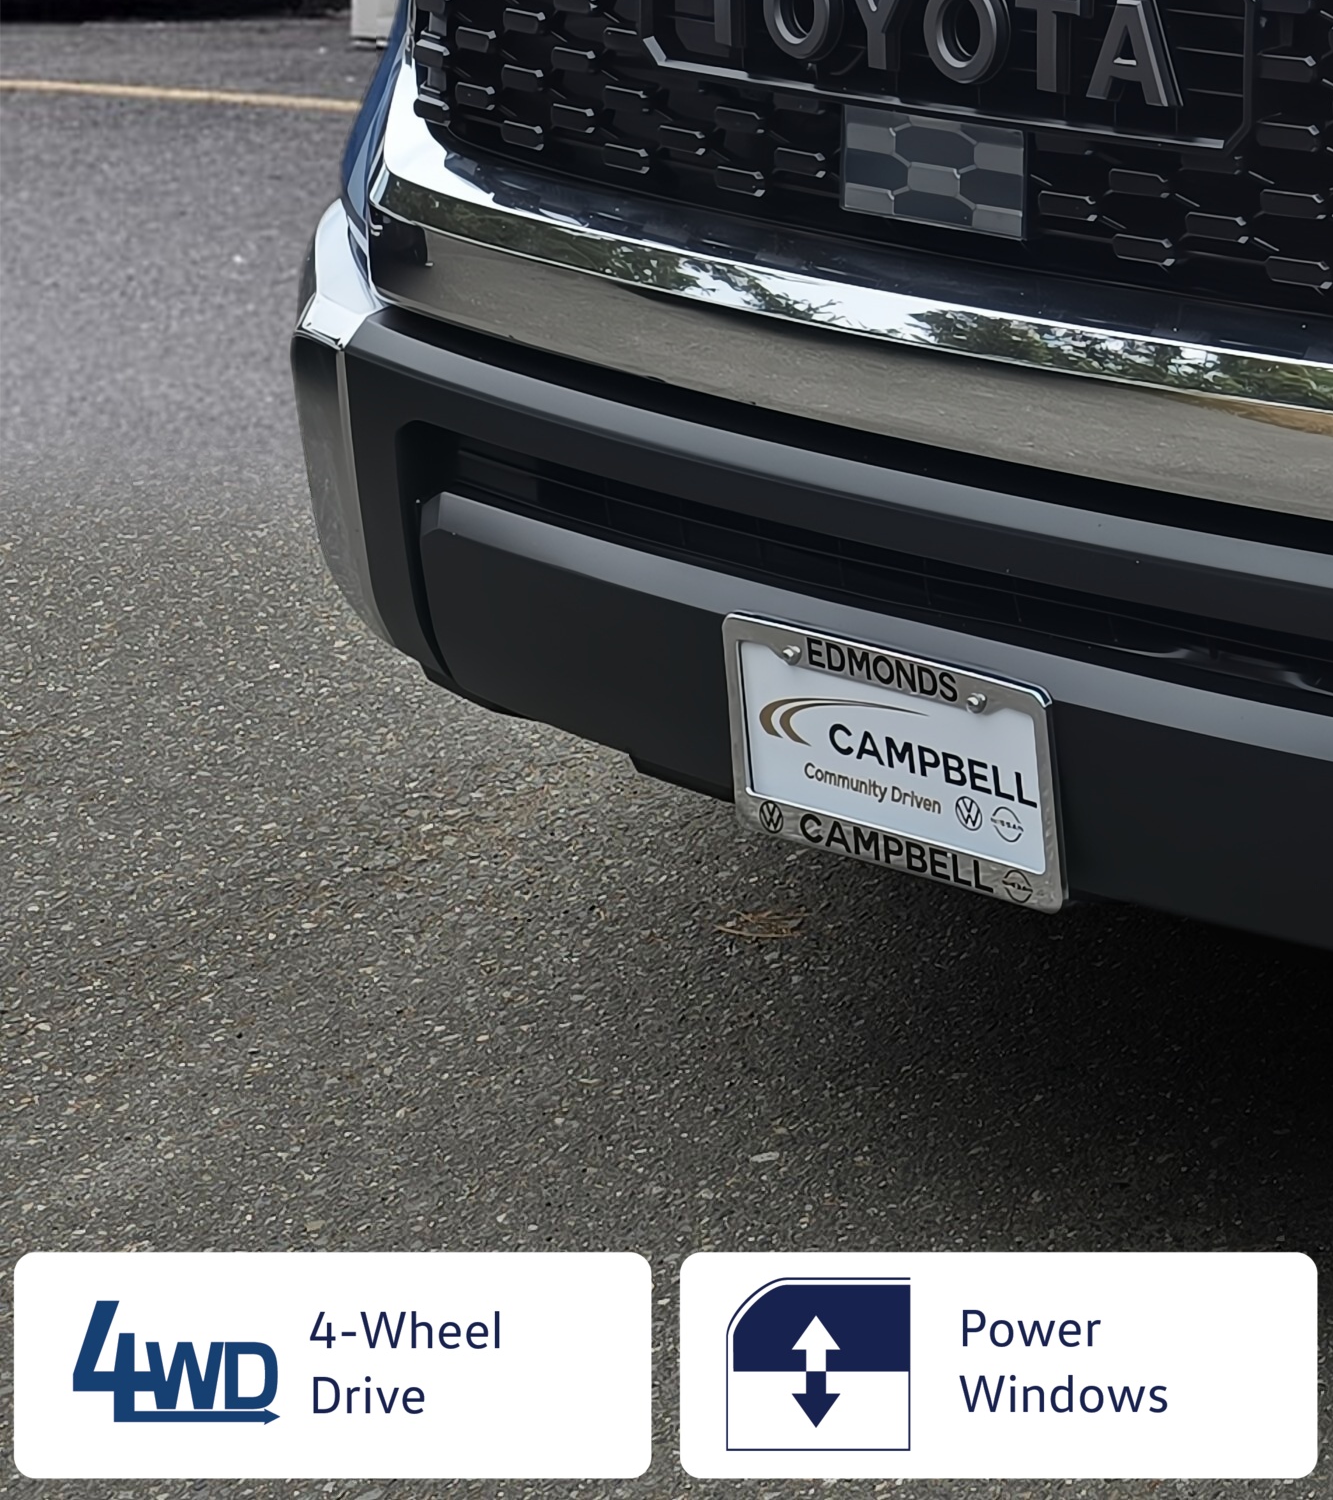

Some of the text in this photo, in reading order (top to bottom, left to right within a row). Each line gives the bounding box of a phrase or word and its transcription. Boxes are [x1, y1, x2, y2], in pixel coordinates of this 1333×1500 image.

[805, 636, 959, 703] EDMONDS
[803, 761, 942, 815] Community Driven
[828, 722, 1039, 809] CAMPBELL
[799, 812, 995, 894] CAMPBELL
